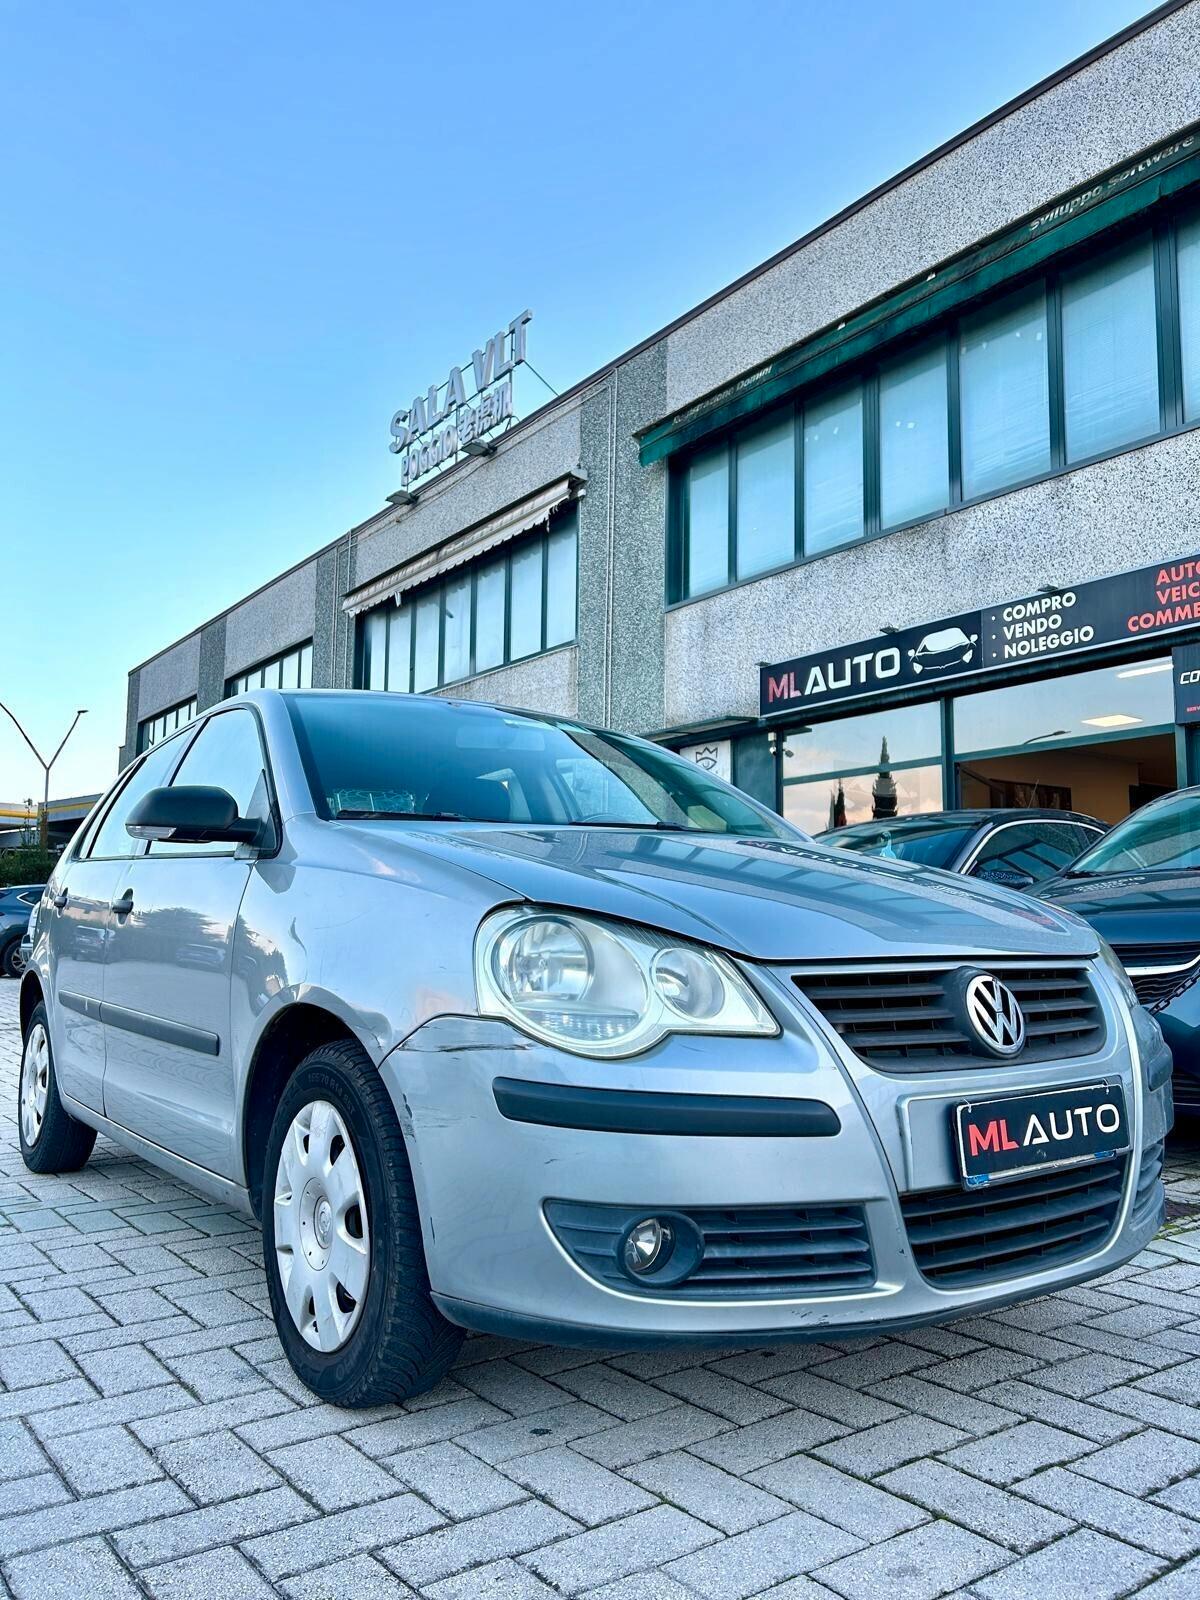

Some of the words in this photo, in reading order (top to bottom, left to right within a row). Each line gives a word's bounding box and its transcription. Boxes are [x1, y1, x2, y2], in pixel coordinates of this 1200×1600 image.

[389, 366, 467, 454] SALA
[472, 309, 533, 393] VLT
[1003, 591, 1077, 623] COMPRO
[1003, 614, 1062, 641] VENDO
[1004, 625, 1095, 660] NOLEGGIO
